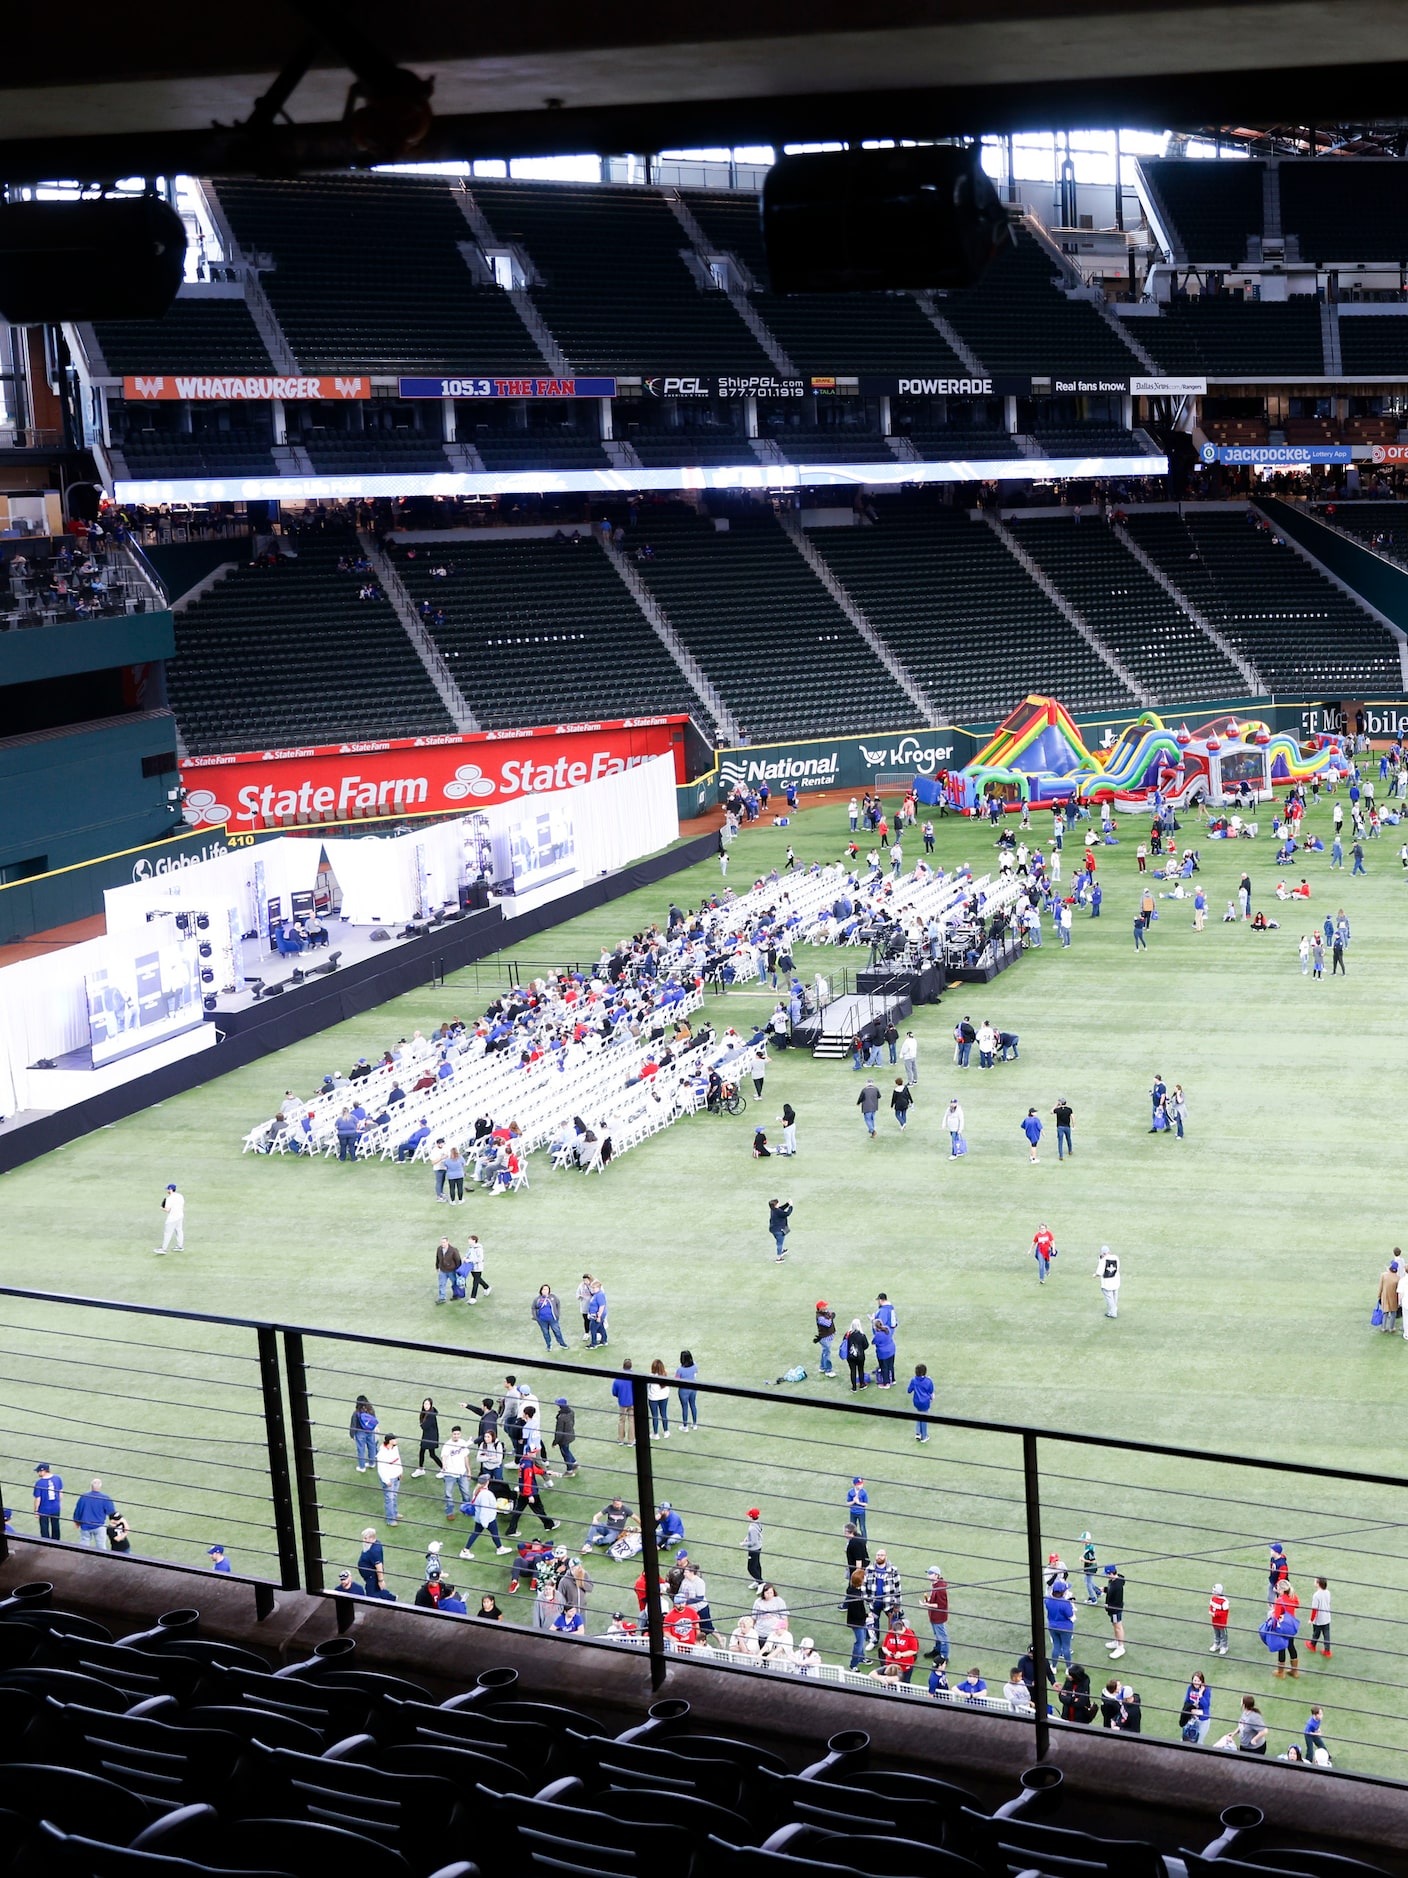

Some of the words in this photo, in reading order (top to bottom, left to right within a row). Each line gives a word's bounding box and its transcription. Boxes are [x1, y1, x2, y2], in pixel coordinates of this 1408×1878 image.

[175, 377, 321, 399] WHATABURGER
[441, 380, 491, 396] 105.3
[494, 380, 532, 396] THE
[536, 380, 576, 396] FAN
[664, 378, 709, 394] PGL
[718, 377, 804, 388] ShipPGL.com
[898, 379, 993, 395] POWERADE
[1055, 381, 1075, 391] Real
[1077, 381, 1097, 391] fans
[1098, 381, 1126, 392] know.
[718, 388, 804, 398] 877.701.1919
[1312, 451, 1334, 459] Lottery
[1334, 451, 1347, 459] App
[891, 737, 953, 774] Kroger
[801, 774, 835, 788] Rental
[227, 835, 255, 848] 410
[202, 841, 229, 862] Life
